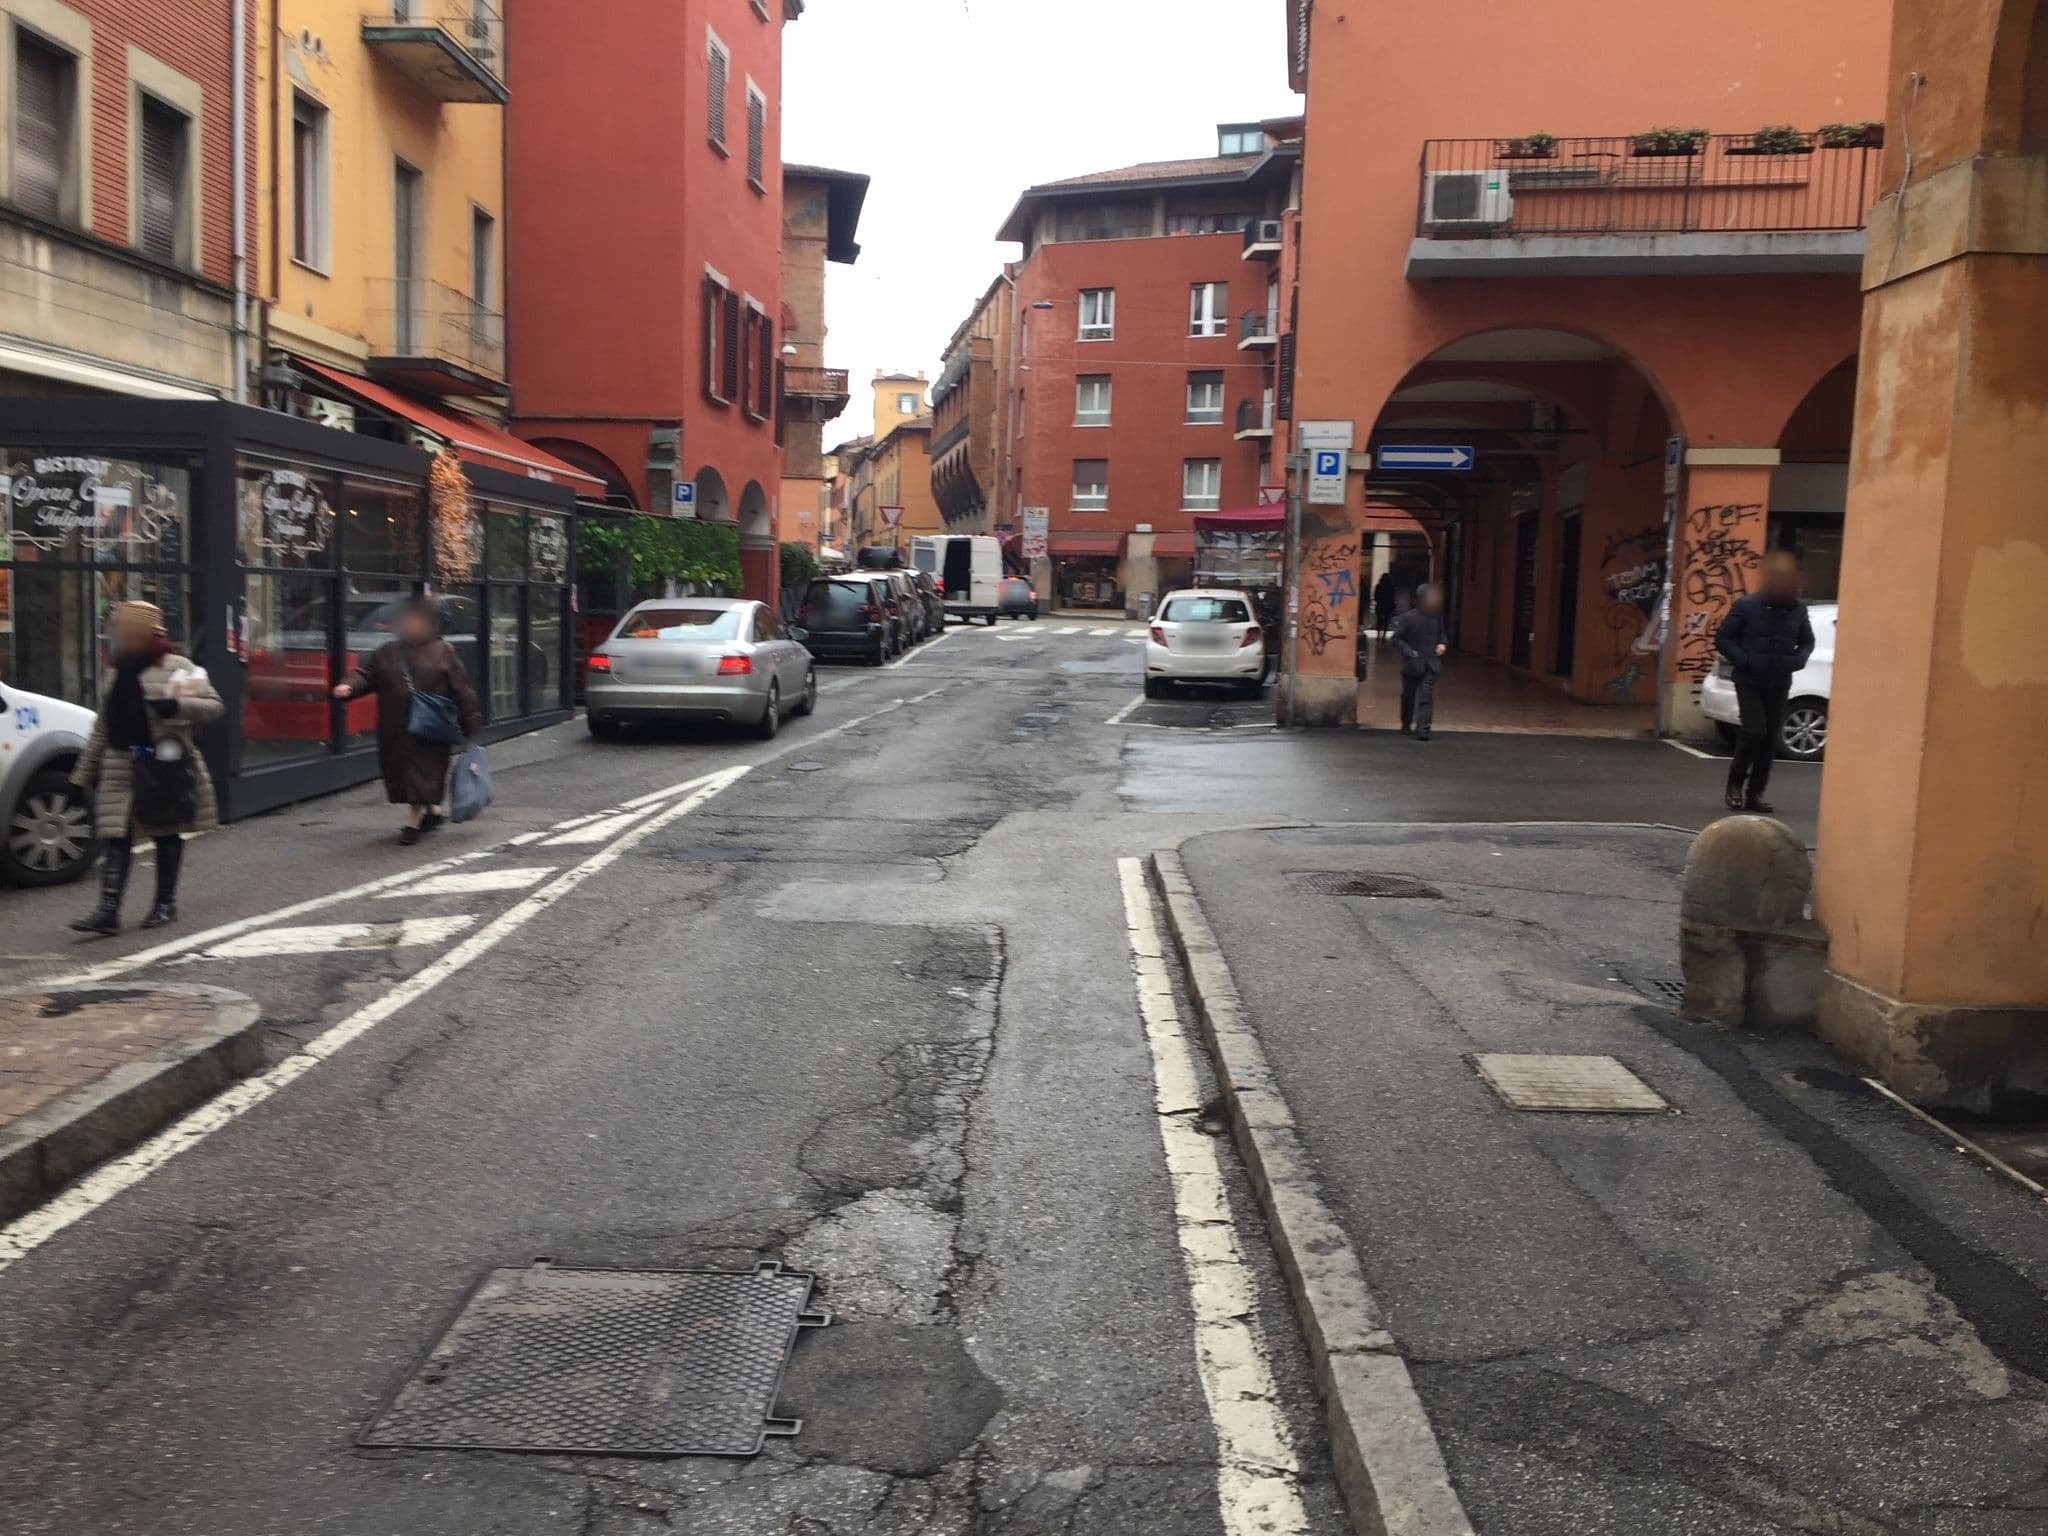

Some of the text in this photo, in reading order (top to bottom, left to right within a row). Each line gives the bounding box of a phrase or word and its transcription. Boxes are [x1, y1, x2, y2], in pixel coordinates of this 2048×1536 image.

[33, 456, 112, 476] BISTROT
[1320, 455, 1336, 472] P
[677, 485, 690, 500] P
